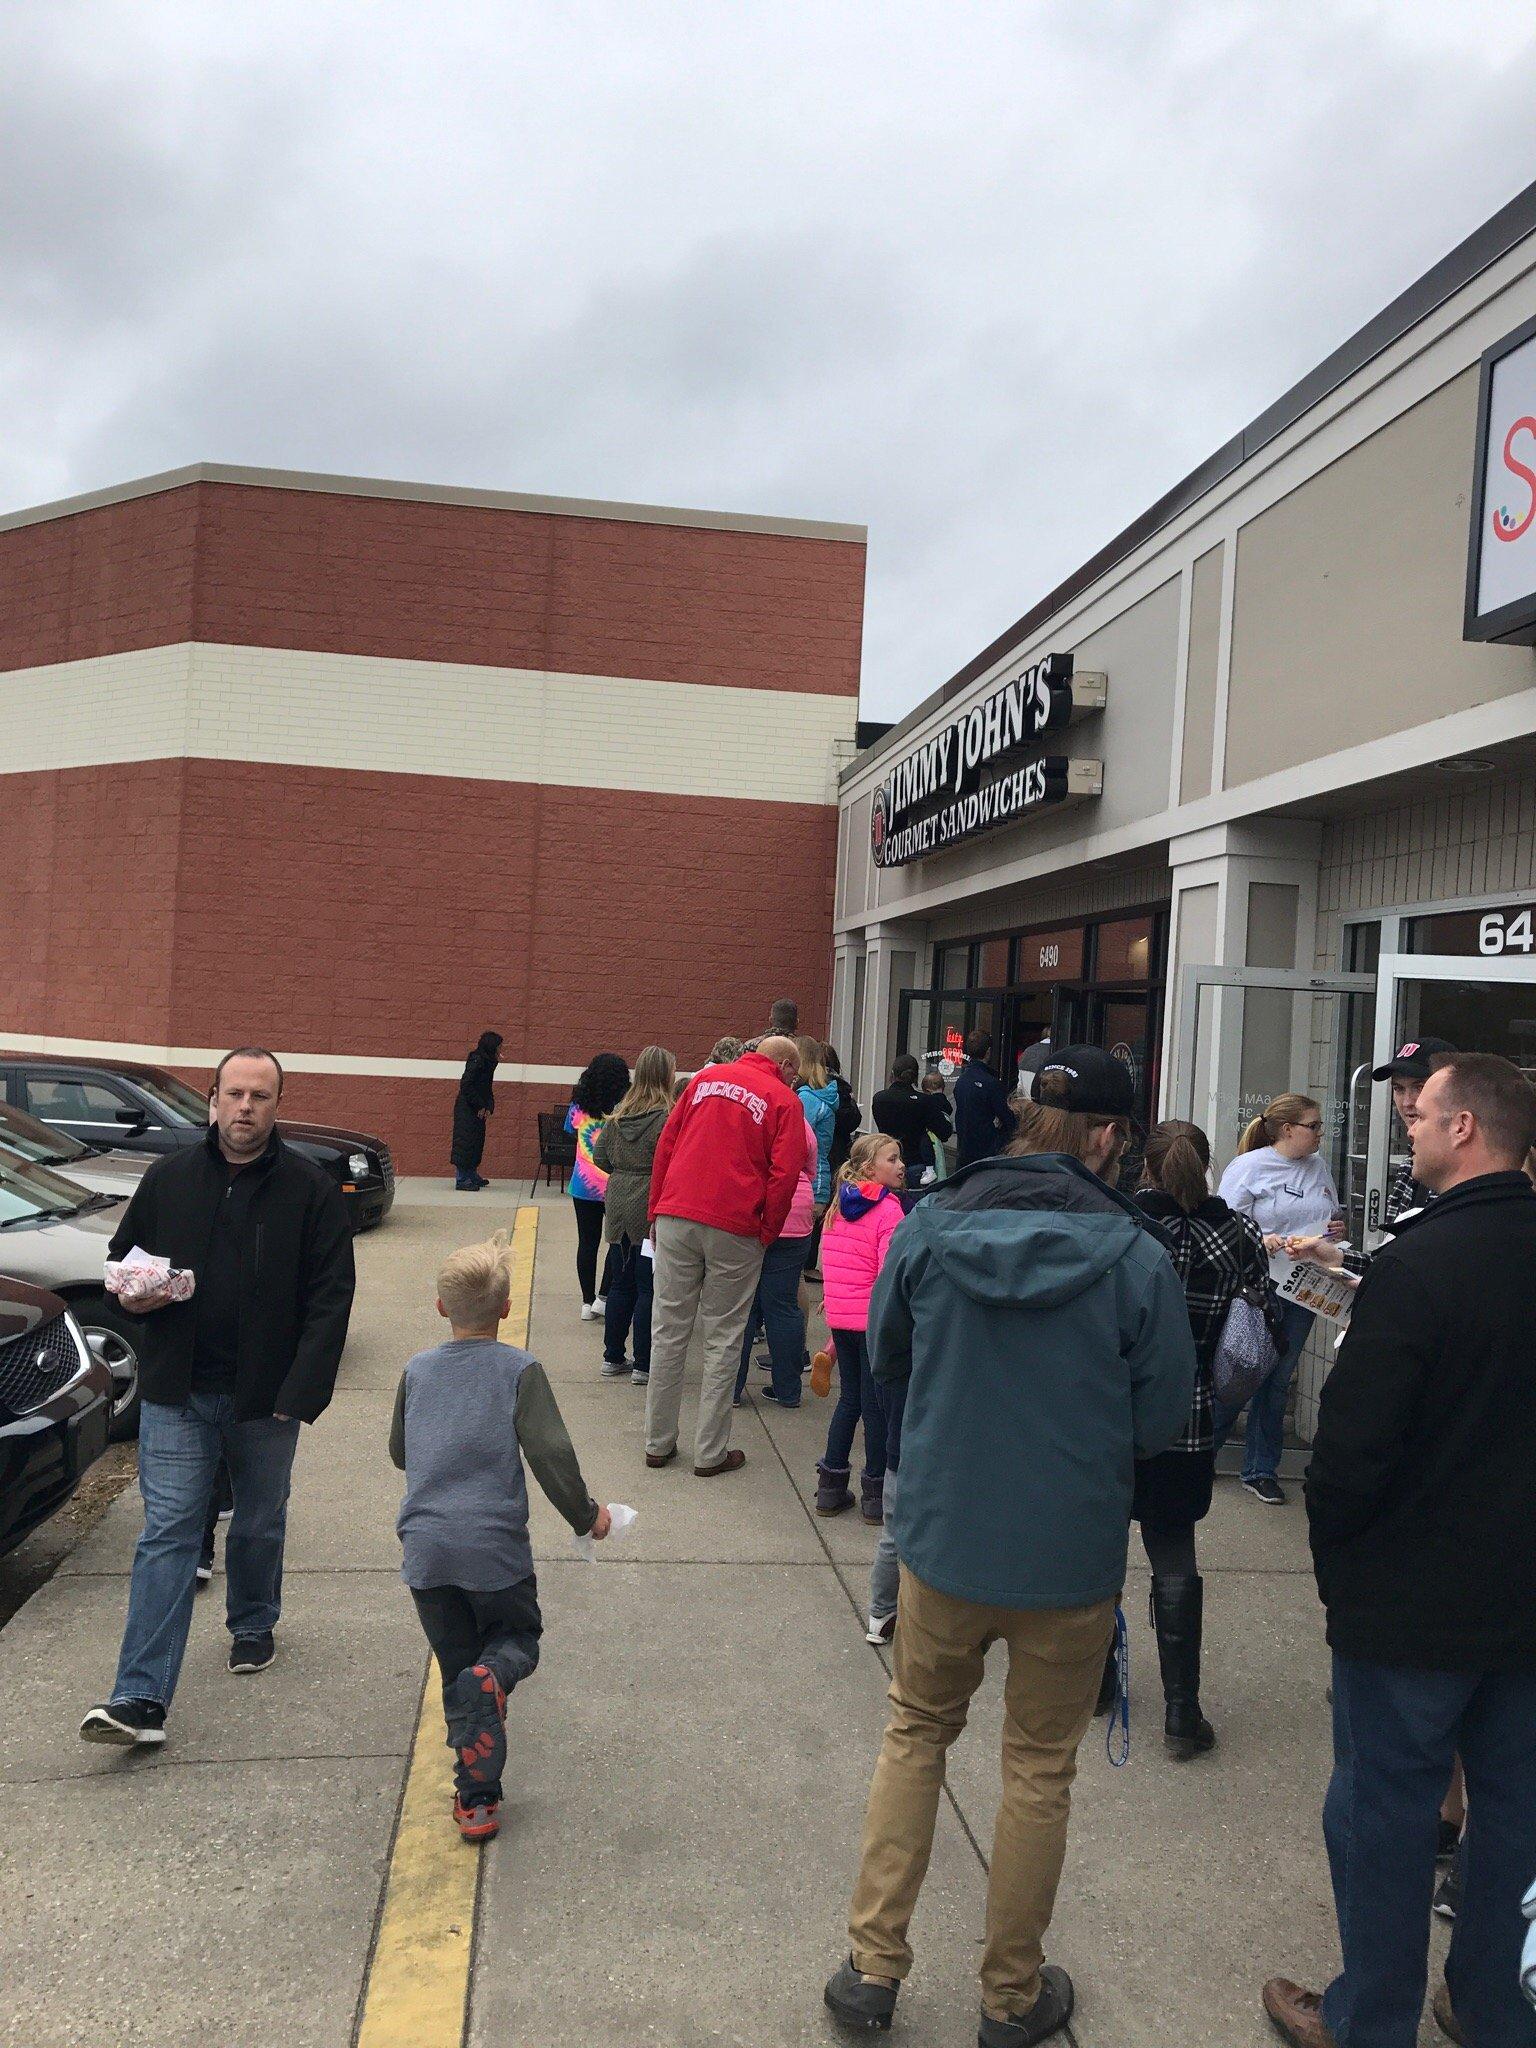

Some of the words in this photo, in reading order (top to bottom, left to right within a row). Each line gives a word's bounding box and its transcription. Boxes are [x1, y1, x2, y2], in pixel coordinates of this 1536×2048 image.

[888, 727, 952, 831] JIMMY
[954, 656, 1052, 794] JOHN'S
[884, 813, 939, 866] GOURMET
[939, 757, 1047, 842] SANDWICHES
[1479, 910, 1534, 955] 64
[1039, 944, 1059, 967] 6490
[692, 1081, 768, 1125] BUCKEYES
[1370, 1191, 1379, 1226] PULL
[1283, 1265, 1304, 1292] $1.00
